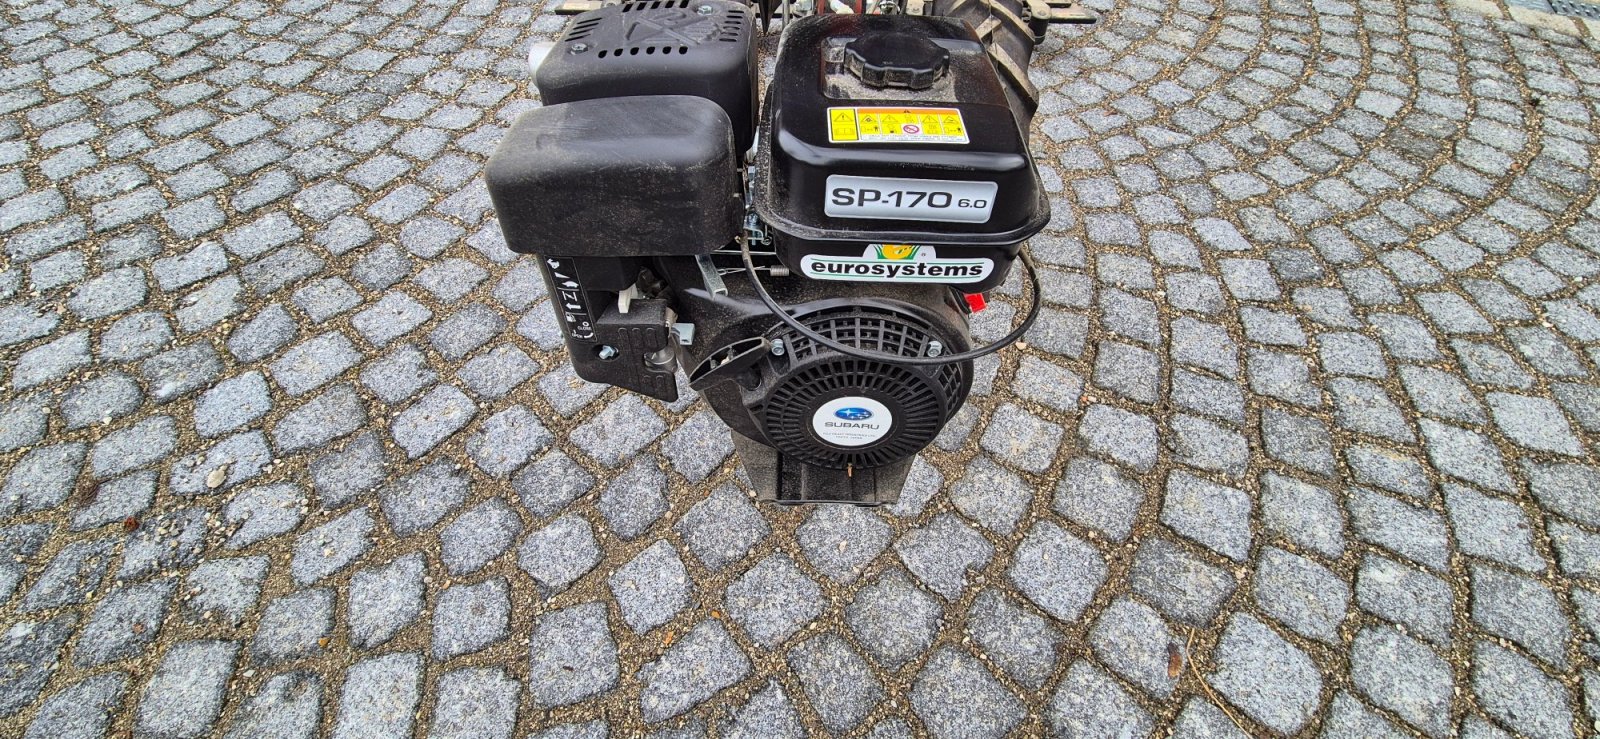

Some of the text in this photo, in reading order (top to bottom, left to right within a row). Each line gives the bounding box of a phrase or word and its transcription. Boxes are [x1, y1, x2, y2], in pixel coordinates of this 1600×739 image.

[831, 187, 988, 209] SP-170 6.0
[811, 261, 983, 278] eurosystems
[824, 422, 880, 430] SUBARU
